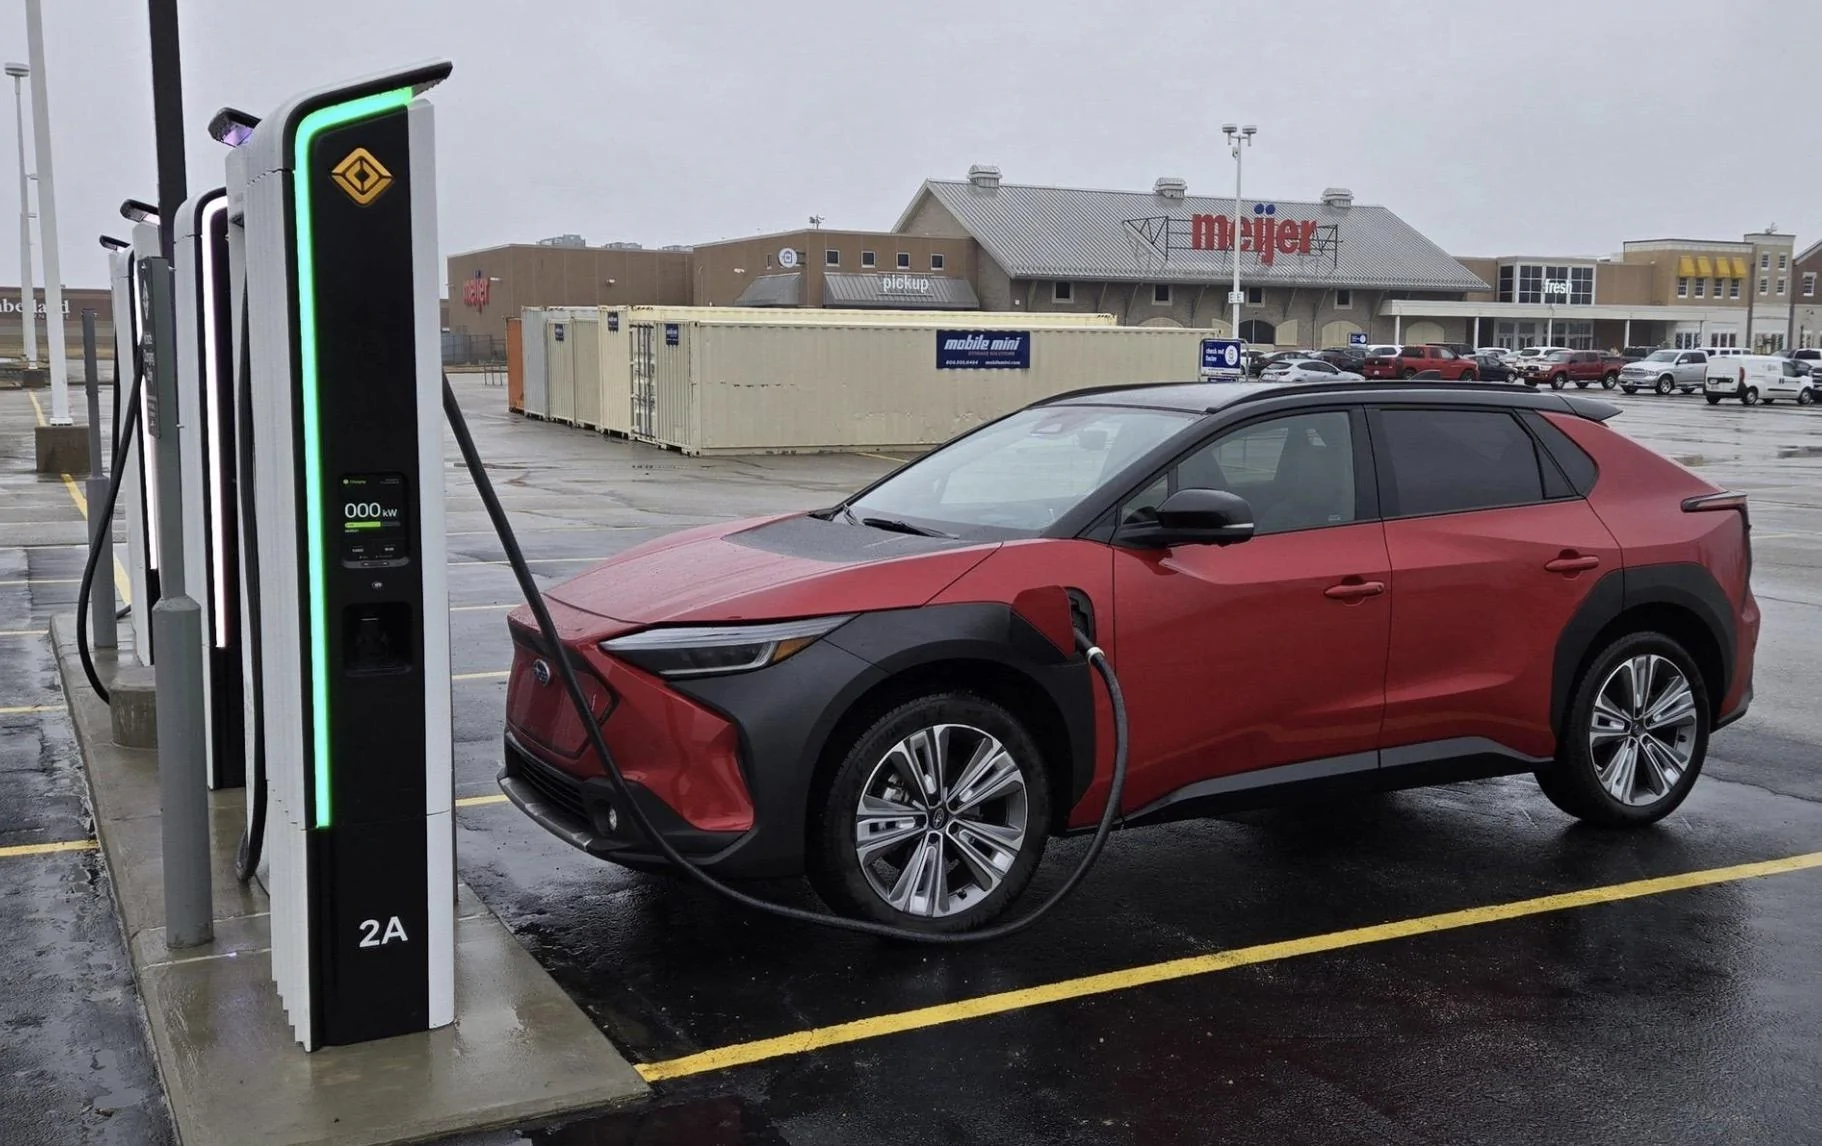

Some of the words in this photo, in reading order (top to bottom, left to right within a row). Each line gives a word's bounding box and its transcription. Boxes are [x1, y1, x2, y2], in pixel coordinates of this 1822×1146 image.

[1192, 204, 1316, 266] meijer
[883, 275, 929, 293] pickup
[1545, 279, 1573, 294] fresh
[943, 334, 990, 350] mobile
[990, 337, 1022, 350] mini
[345, 502, 381, 518] 000
[382, 509, 398, 517] kW
[359, 916, 409, 947] 2A
